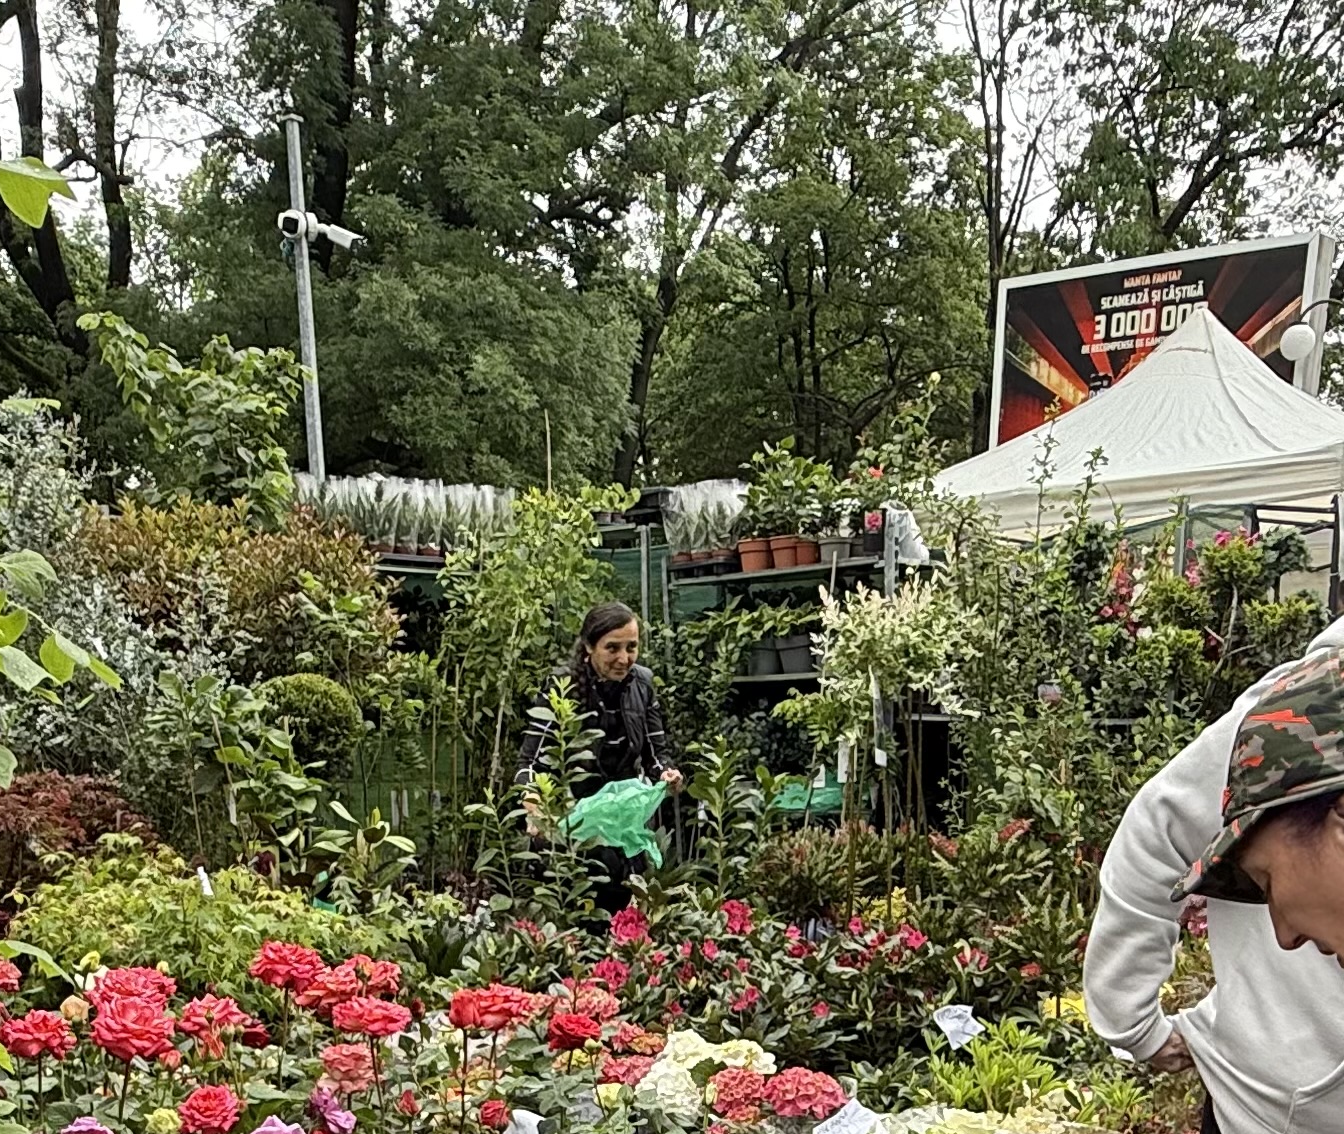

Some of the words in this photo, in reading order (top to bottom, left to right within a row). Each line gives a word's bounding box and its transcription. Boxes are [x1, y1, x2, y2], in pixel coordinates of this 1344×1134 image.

[1100, 286, 1150, 310] SCANEAZĂ
[1093, 314, 1107, 341] 3
[1110, 308, 1157, 338] 000
[1160, 301, 1209, 332] 00
